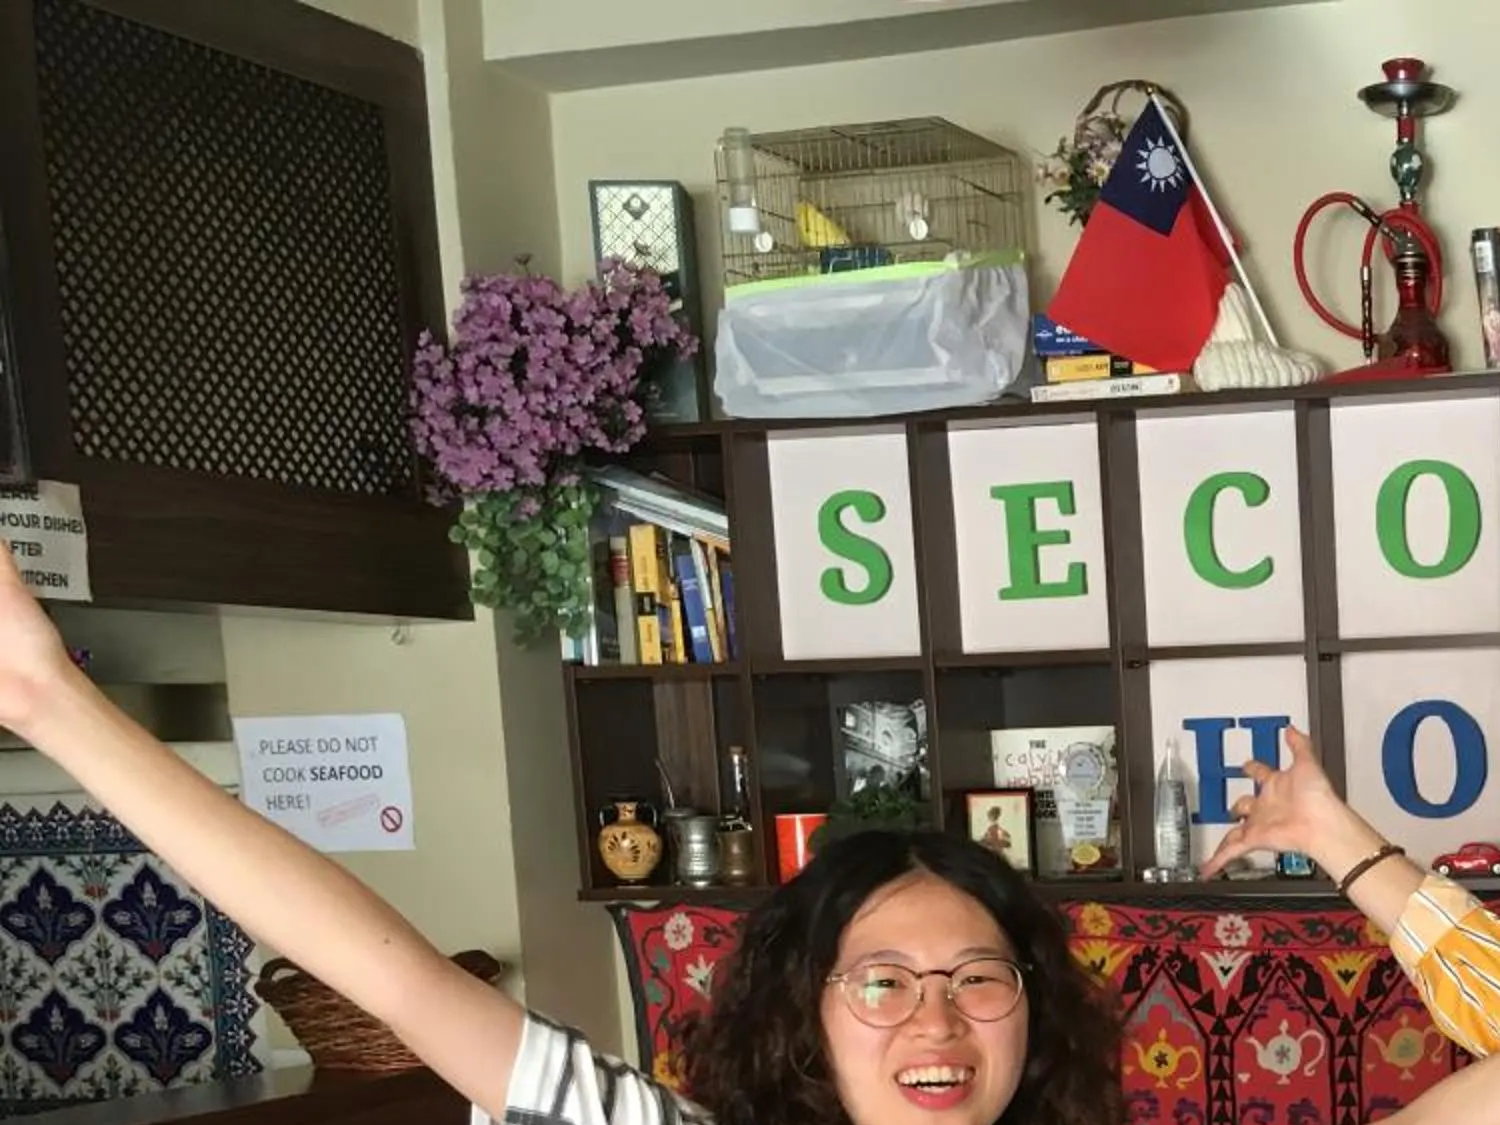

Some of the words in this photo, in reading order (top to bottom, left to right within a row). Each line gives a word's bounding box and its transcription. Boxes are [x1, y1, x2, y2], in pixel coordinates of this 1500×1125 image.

[8, 540, 43, 557] FTER
[258, 738, 312, 755] PLEASE
[317, 737, 341, 753] DO
[346, 736, 378, 753] NOT
[262, 767, 306, 783] COOK
[309, 765, 383, 782] SEAFOOD
[266, 794, 311, 811] HERE!
